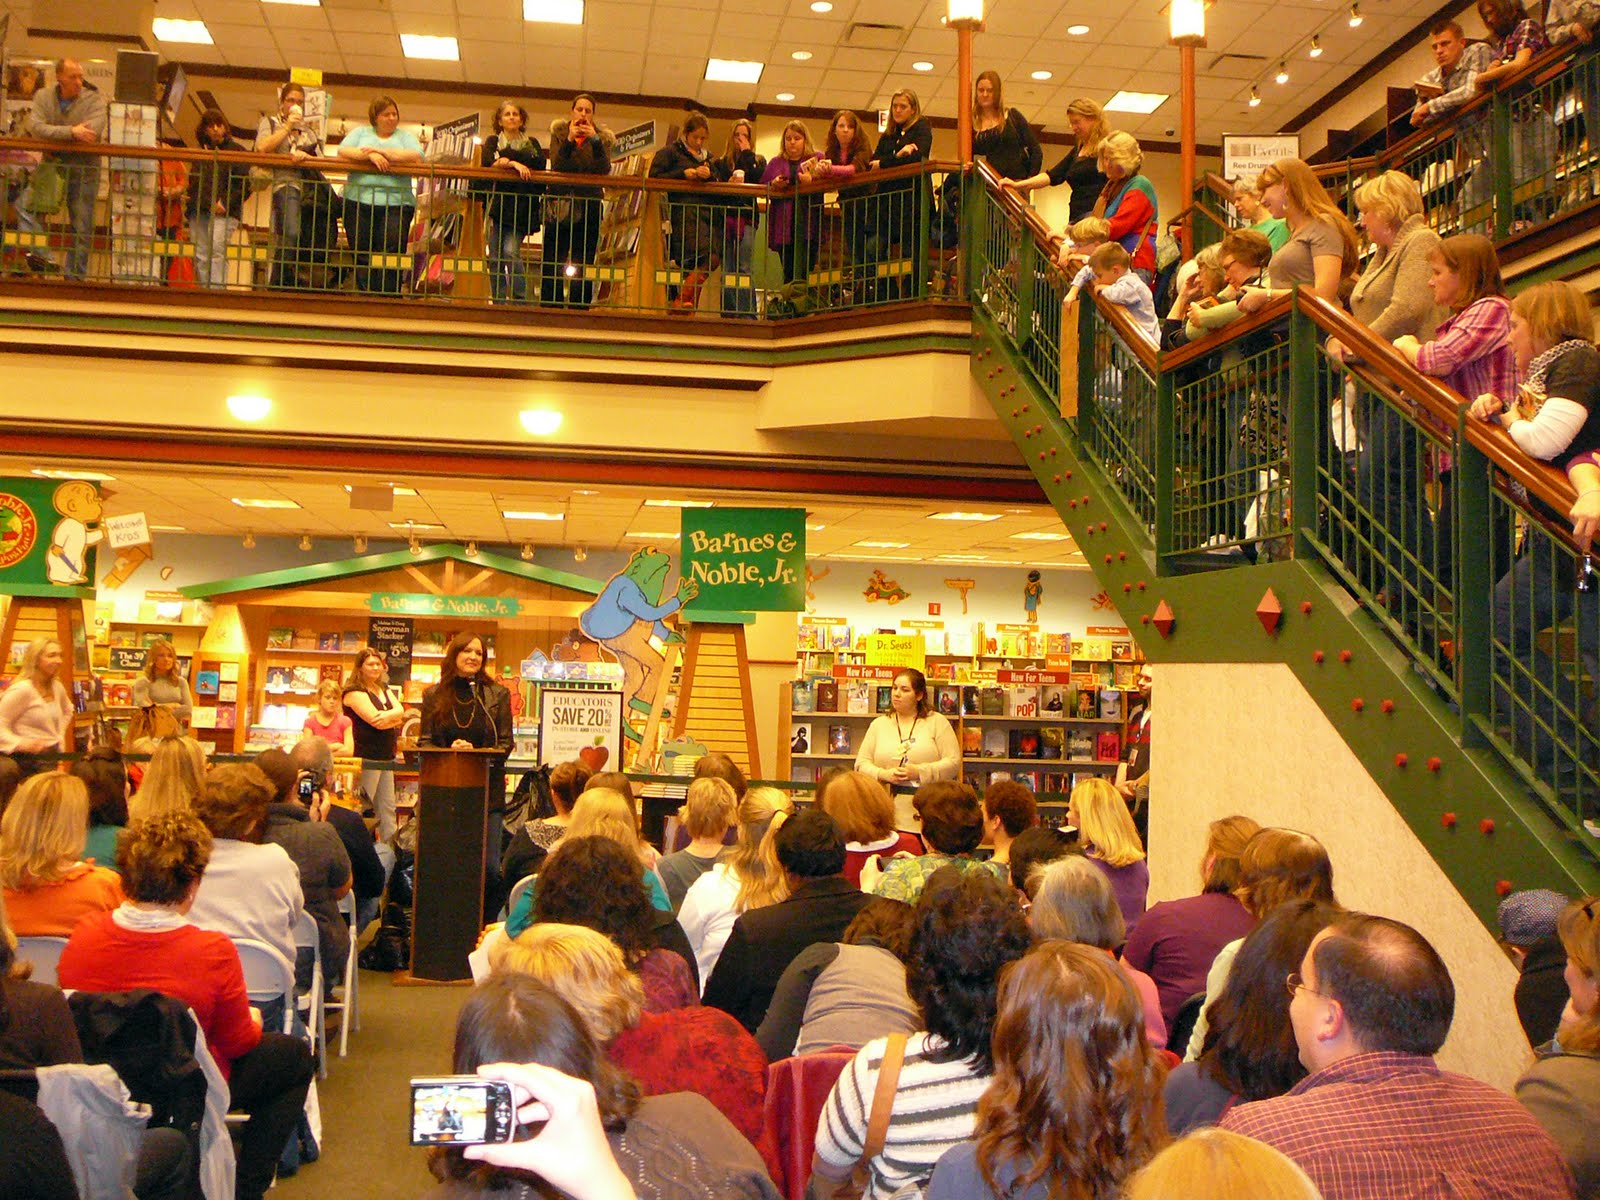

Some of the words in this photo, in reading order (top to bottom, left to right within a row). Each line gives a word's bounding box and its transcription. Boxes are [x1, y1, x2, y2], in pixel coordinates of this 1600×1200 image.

[1253, 144, 1294, 156] Events
[109, 518, 143, 530] WELCOME
[115, 531, 140, 543] KIDS
[689, 530, 775, 554] Barnes
[777, 532, 797, 553] &
[689, 560, 765, 588] Noble,
[767, 558, 798, 585] Jr.
[380, 596, 430, 610] Barnes
[432, 598, 445, 612] &
[447, 600, 490, 614] Noble,
[491, 600, 509, 614] Jr.
[372, 623, 410, 633] Snowman
[377, 631, 405, 640] Stacker
[890, 640, 912, 650] Seuss
[118, 651, 132, 660] The
[120, 659, 141, 668] Clues
[846, 667, 860, 677] New
[861, 668, 873, 677] For
[875, 668, 893, 678] Teens
[1010, 672, 1024, 682] New
[1025, 673, 1037, 683] For
[1038, 673, 1056, 683] Teens
[553, 696, 613, 707] EDUCATORS
[1016, 704, 1035, 717] POP
[1076, 711, 1096, 719] LIAR
[552, 707, 585, 726] SAVE
[587, 708, 604, 727] 20
